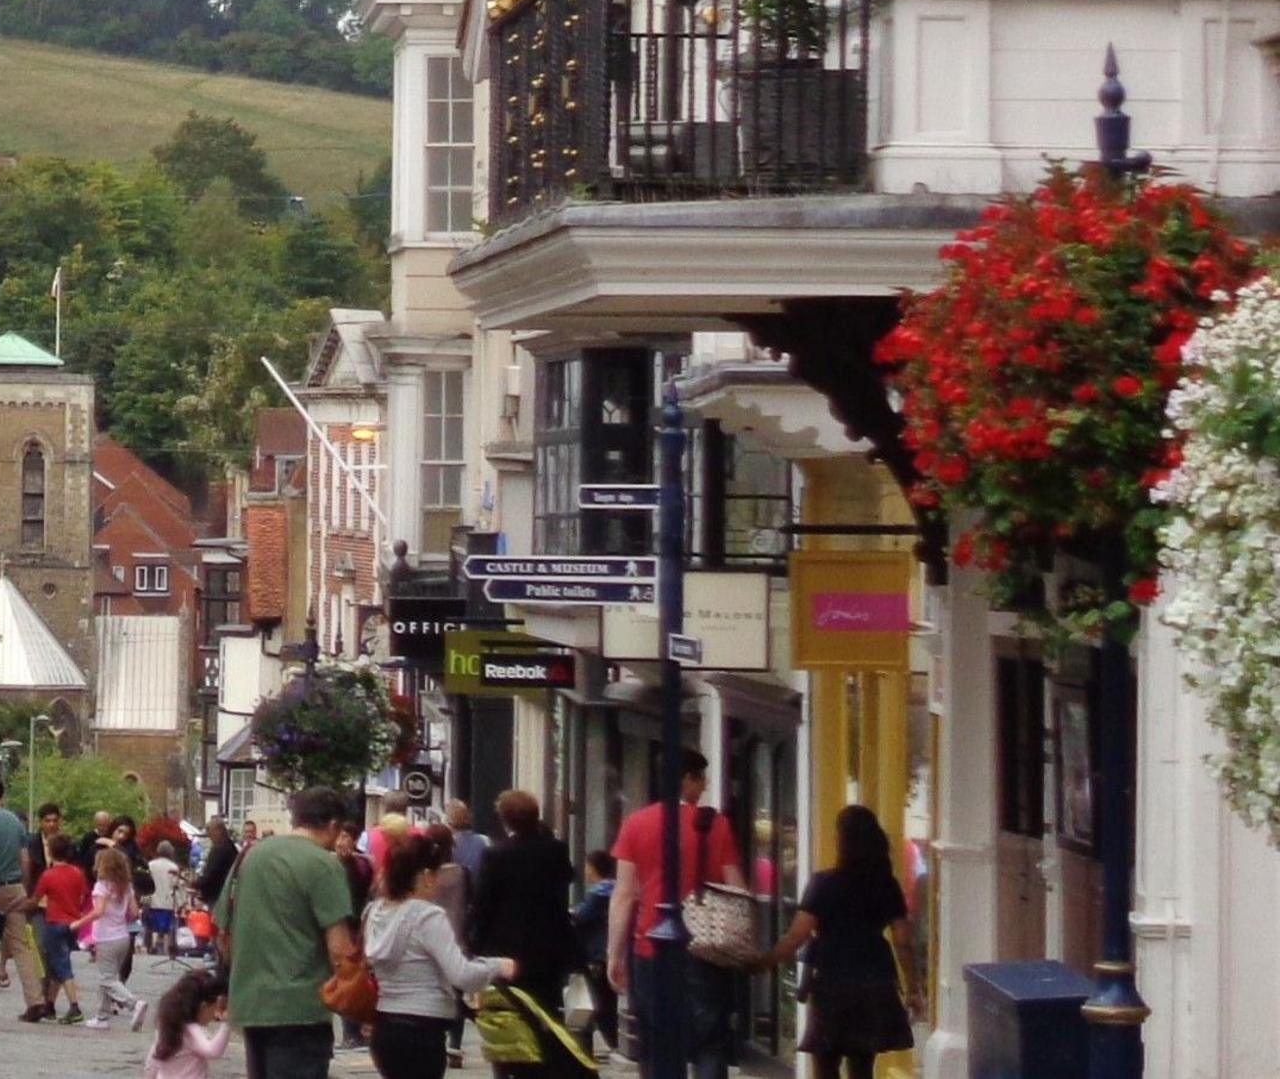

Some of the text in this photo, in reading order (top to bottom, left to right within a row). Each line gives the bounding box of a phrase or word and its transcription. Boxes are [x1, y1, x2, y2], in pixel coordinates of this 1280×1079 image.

[485, 562, 609, 575] CASTLE & MUSEUM
[525, 584, 598, 598] Public toilets
[484, 663, 547, 679] Reebok
